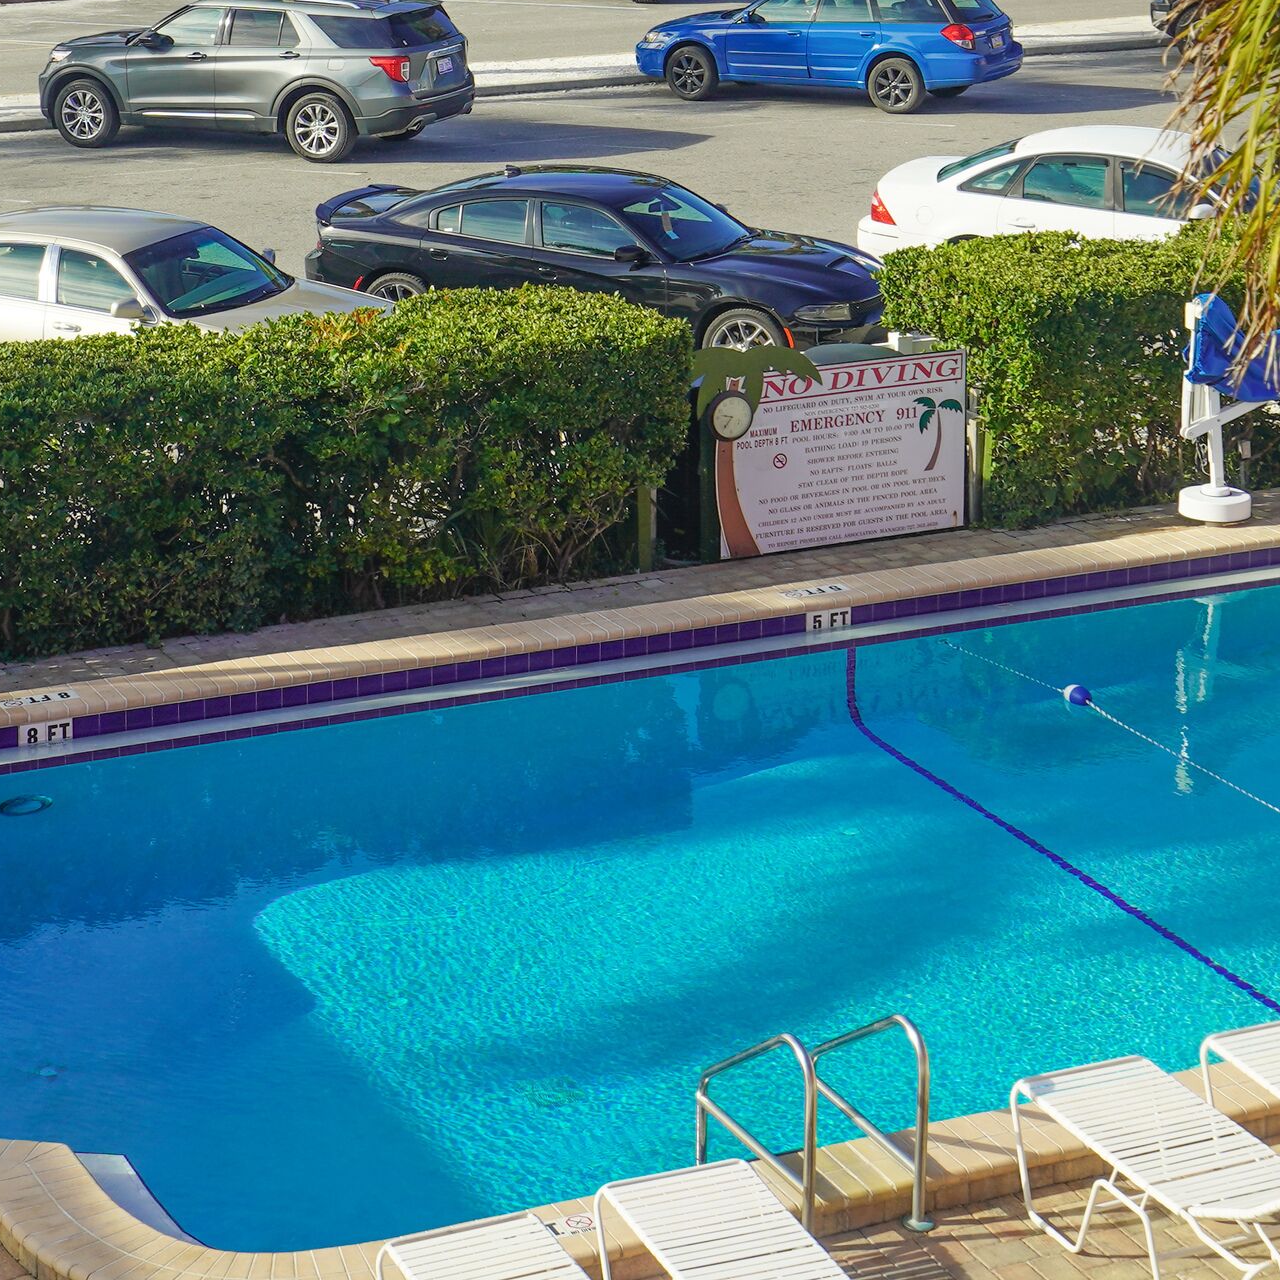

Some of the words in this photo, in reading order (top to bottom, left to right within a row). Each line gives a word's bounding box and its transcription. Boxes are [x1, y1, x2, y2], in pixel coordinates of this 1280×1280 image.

[764, 376, 813, 398] NO
[828, 358, 959, 390] DIVING
[776, 402, 816, 412] LIFEGUARD
[831, 397, 852, 406] DUTY,
[790, 410, 886, 433] EMERGENCY
[896, 407, 918, 420] 911
[750, 427, 778, 438] MAXIMUM
[737, 440, 752, 450] POOL
[755, 438, 774, 448] DEPTH
[780, 437, 788, 445] FT
[805, 444, 835, 453] BATHING
[871, 436, 902, 444] PERSONS
[808, 456, 835, 464] SHOWER
[838, 453, 862, 461] BEFORE
[866, 448, 899, 457] ENTERING
[798, 481, 814, 489] STAY
[816, 478, 837, 486] CLEAR
[801, 490, 840, 500] BEVERAGES
[780, 505, 801, 513] GLASS
[815, 500, 844, 508] ANIMALS
[758, 519, 788, 527] CHILDREN
[864, 503, 905, 514] ACCOMPANIED
[755, 530, 795, 540] FURNITURE
[806, 523, 841, 532] RESERVED
[858, 517, 883, 525] GUESTS
[930, 508, 947, 516] AREA
[800, 536, 827, 544] PROBLEMS
[844, 529, 878, 538] ASSOCIATION
[813, 615, 822, 629] 5
[830, 611, 848, 627] FT
[27, 728, 38, 743] 8
